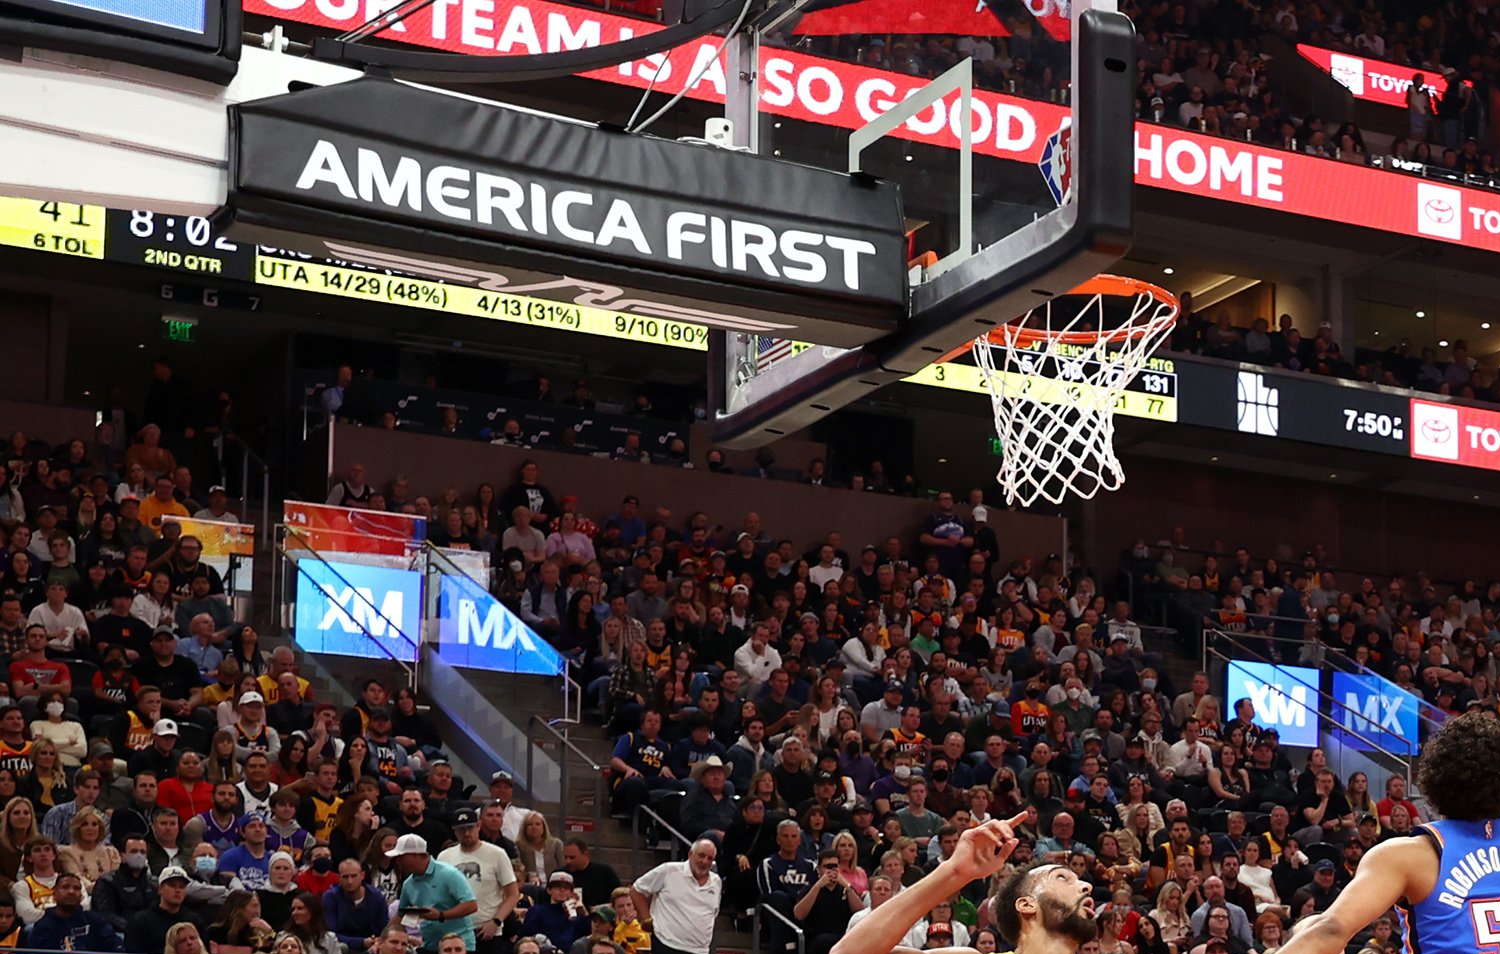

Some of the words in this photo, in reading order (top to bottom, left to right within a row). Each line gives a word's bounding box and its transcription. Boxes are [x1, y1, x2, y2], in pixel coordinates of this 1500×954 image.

[1134, 132, 1284, 203] HOME
[295, 139, 664, 250] AMERICA
[666, 210, 876, 291] FIRST
[33, 233, 46, 248] 6
[52, 234, 94, 256] TOL
[144, 248, 182, 267] 2ND
[184, 252, 222, 274] QTR
[203, 288, 219, 308] G
[259, 260, 309, 284] UTA
[320, 270, 381, 296] 14/29
[386, 280, 448, 308] (48%)
[477, 295, 521, 317] 4/13
[527, 301, 581, 328] (31%)
[615, 315, 658, 338] 9/10
[935, 366, 945, 381] 3
[1147, 397, 1165, 414] 77
[1142, 374, 1169, 394] 131
[1343, 409, 1393, 437] 7:50
[317, 583, 404, 639] XM
[1244, 681, 1306, 727] XM
[378, 761, 398, 777] 45
[932, 923, 949, 932] UTAH
